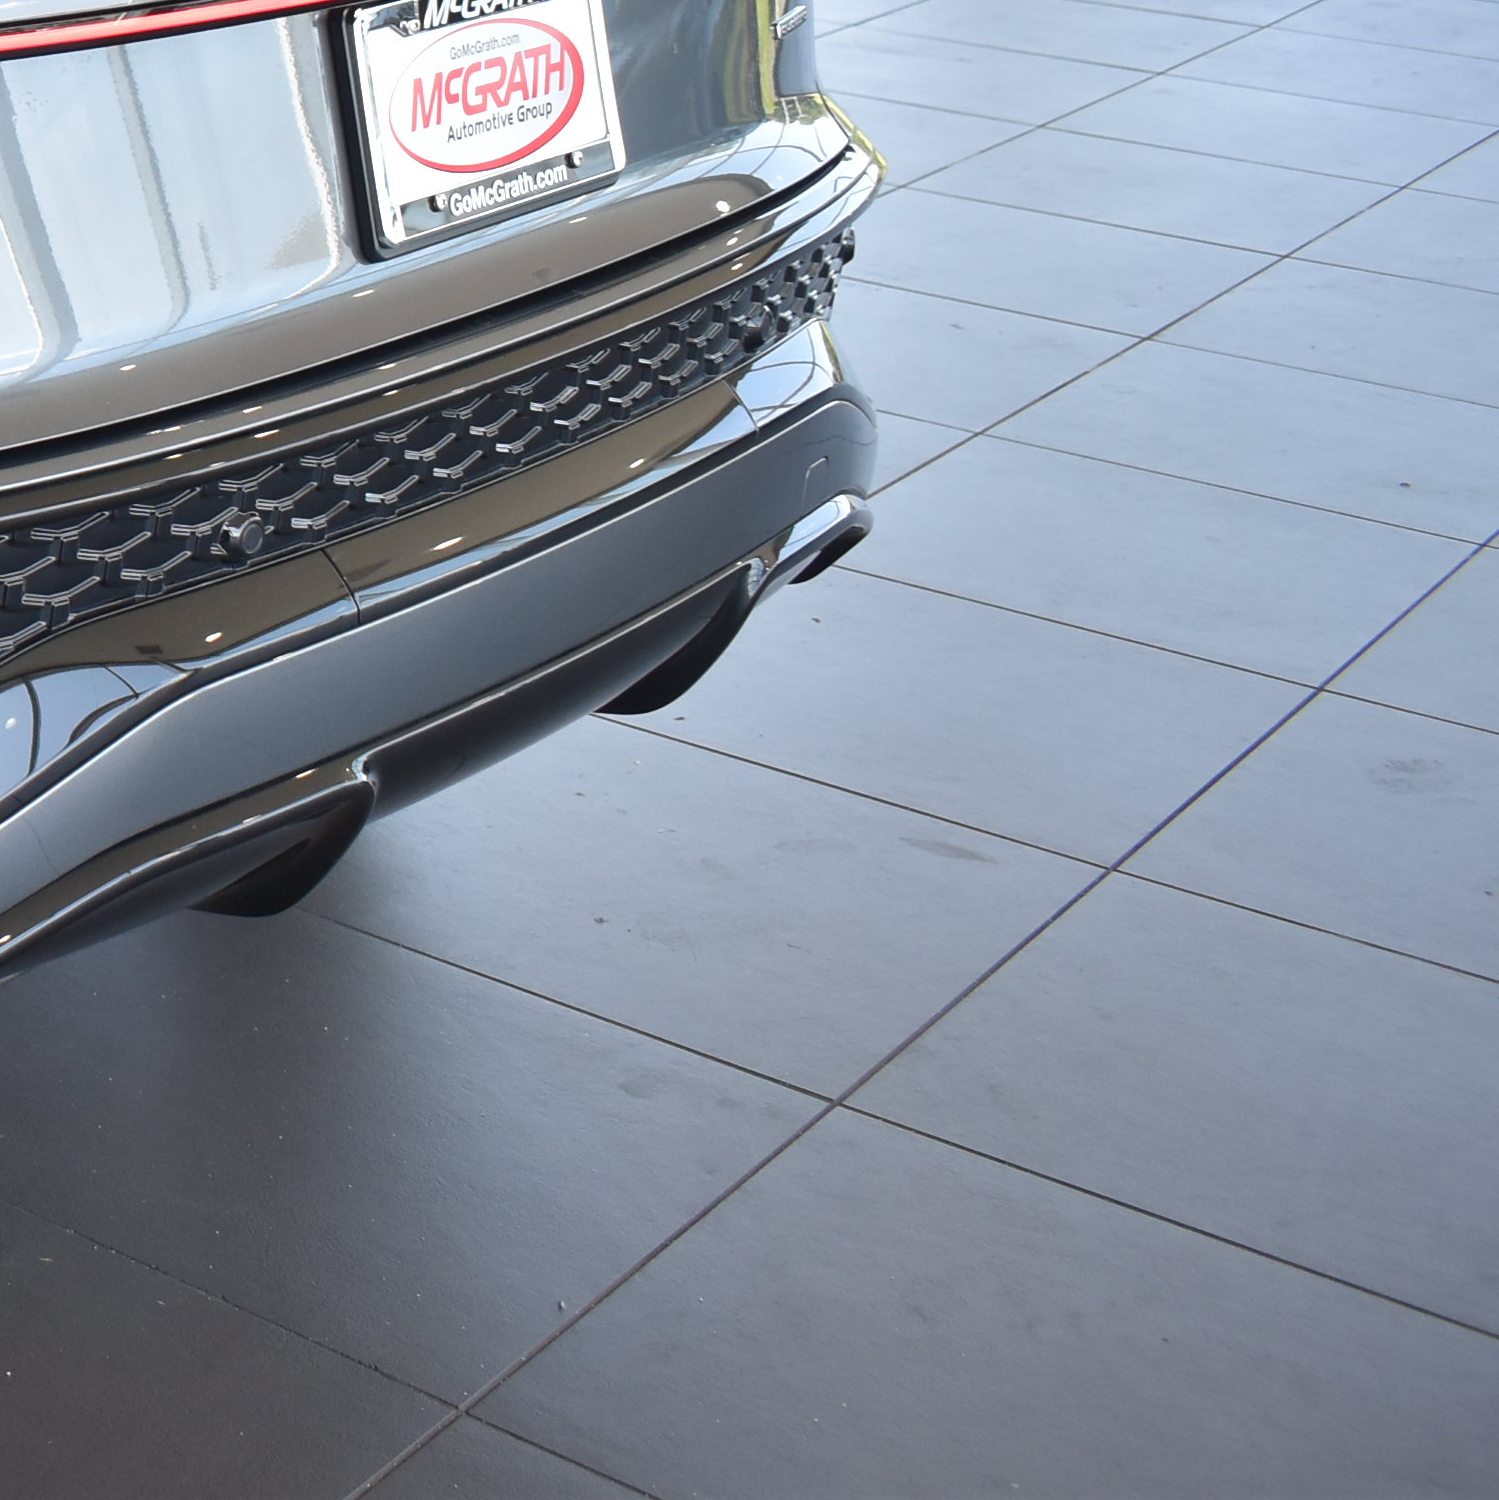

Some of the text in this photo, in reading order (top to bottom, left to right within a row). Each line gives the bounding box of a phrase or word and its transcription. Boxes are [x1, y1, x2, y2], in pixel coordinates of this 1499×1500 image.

[450, 34, 520, 60] GoMcGrath.com
[411, 43, 566, 132] McGRATH
[447, 102, 553, 143] Automotive Group
[450, 163, 568, 216] GoMcGrath.com
